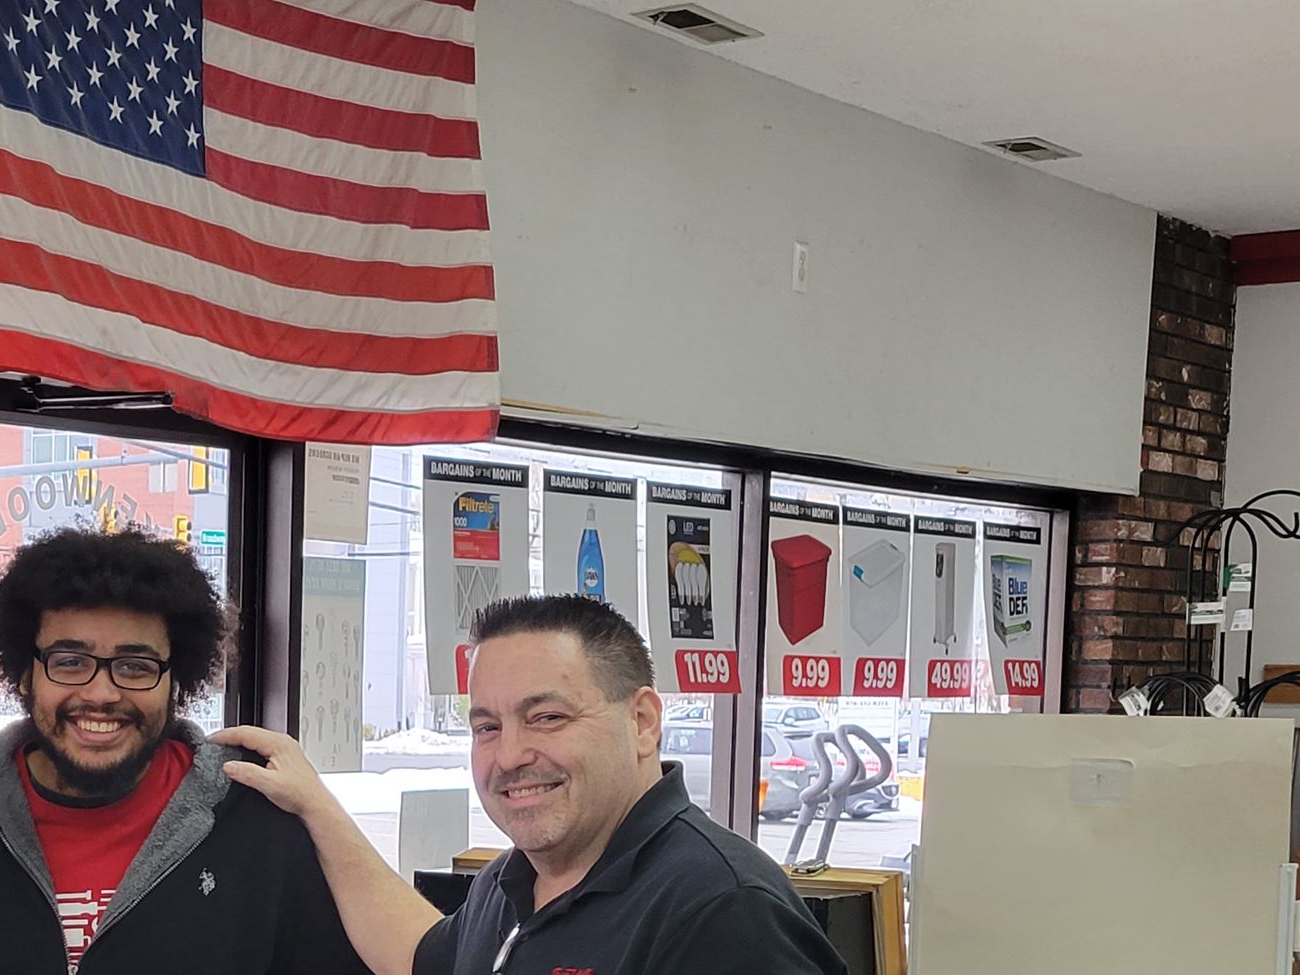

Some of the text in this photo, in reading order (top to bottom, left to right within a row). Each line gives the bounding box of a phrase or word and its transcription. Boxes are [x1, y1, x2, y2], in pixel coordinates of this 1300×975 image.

[431, 461, 475, 478] BARGAINS
[492, 468, 522, 482] MONTH
[550, 475, 589, 490] BARGAINS
[605, 481, 632, 494] MONTH
[652, 487, 687, 500] BARGAINS
[701, 492, 726, 505] MONTH
[770, 501, 799, 516] BARGAINS
[812, 507, 833, 520] MONTH
[847, 511, 875, 523] BARGAINS
[886, 515, 907, 527] MONTH
[1008, 577, 1028, 595] Blue
[1009, 596, 1028, 616] DEF
[684, 652, 730, 684] 11.99
[791, 658, 829, 687] 9.99
[863, 660, 897, 689] 9.99
[931, 661, 969, 689] 49.99
[1008, 661, 1038, 688] 14.99
